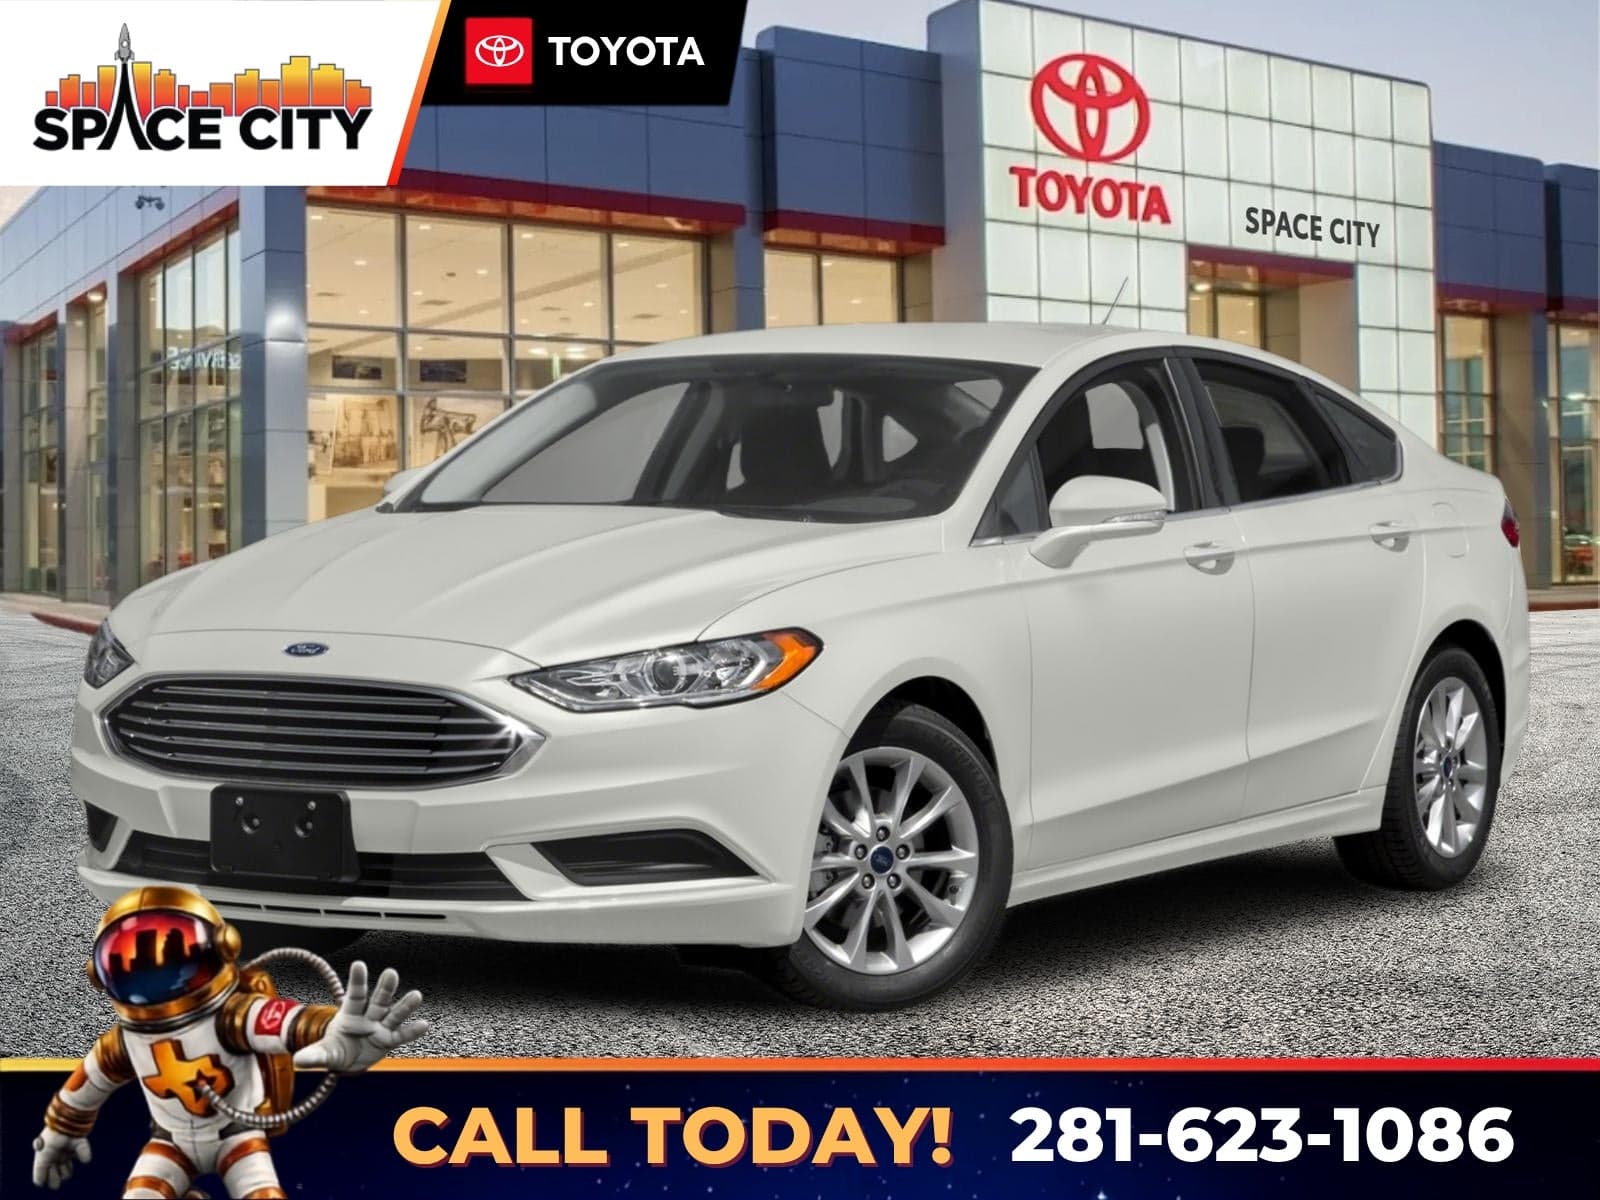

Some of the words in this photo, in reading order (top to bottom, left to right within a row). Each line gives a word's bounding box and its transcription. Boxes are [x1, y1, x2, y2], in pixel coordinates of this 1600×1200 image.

[1009, 166, 1171, 225] TOYOTA
[1245, 207, 1323, 243] SPACE
[1329, 217, 1381, 249] CITY
